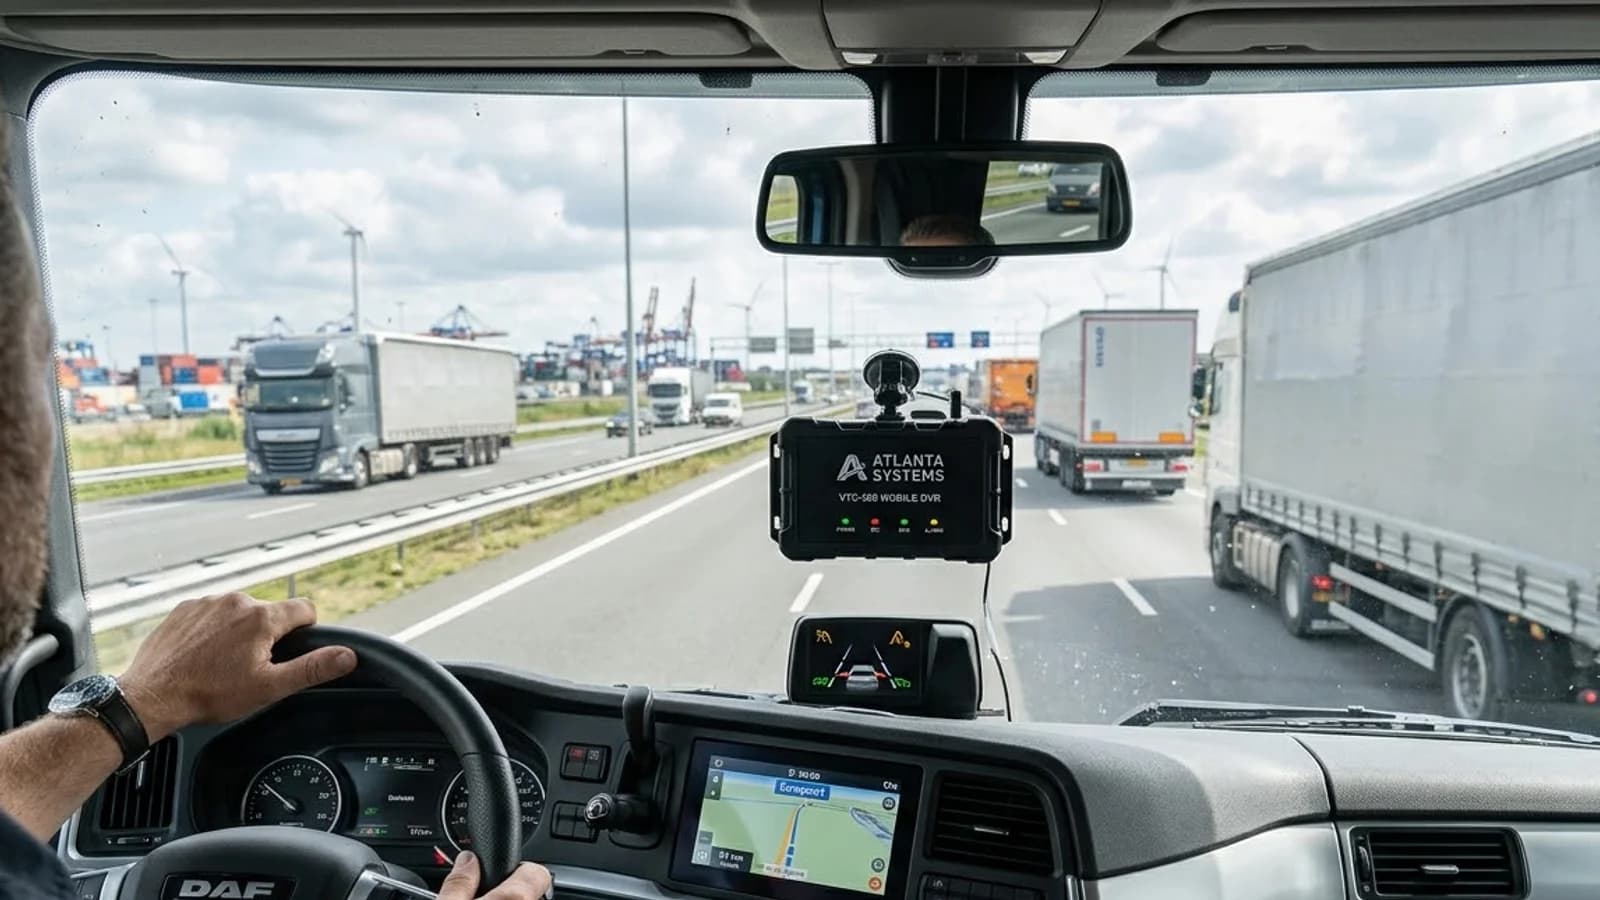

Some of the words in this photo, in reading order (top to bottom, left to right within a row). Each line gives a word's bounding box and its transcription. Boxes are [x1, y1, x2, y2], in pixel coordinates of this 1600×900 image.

[872, 454, 945, 468] ATLANTA
[872, 468, 945, 483] SYSTEMS
[920, 493, 942, 503] DVR
[178, 879, 275, 899] DAF
